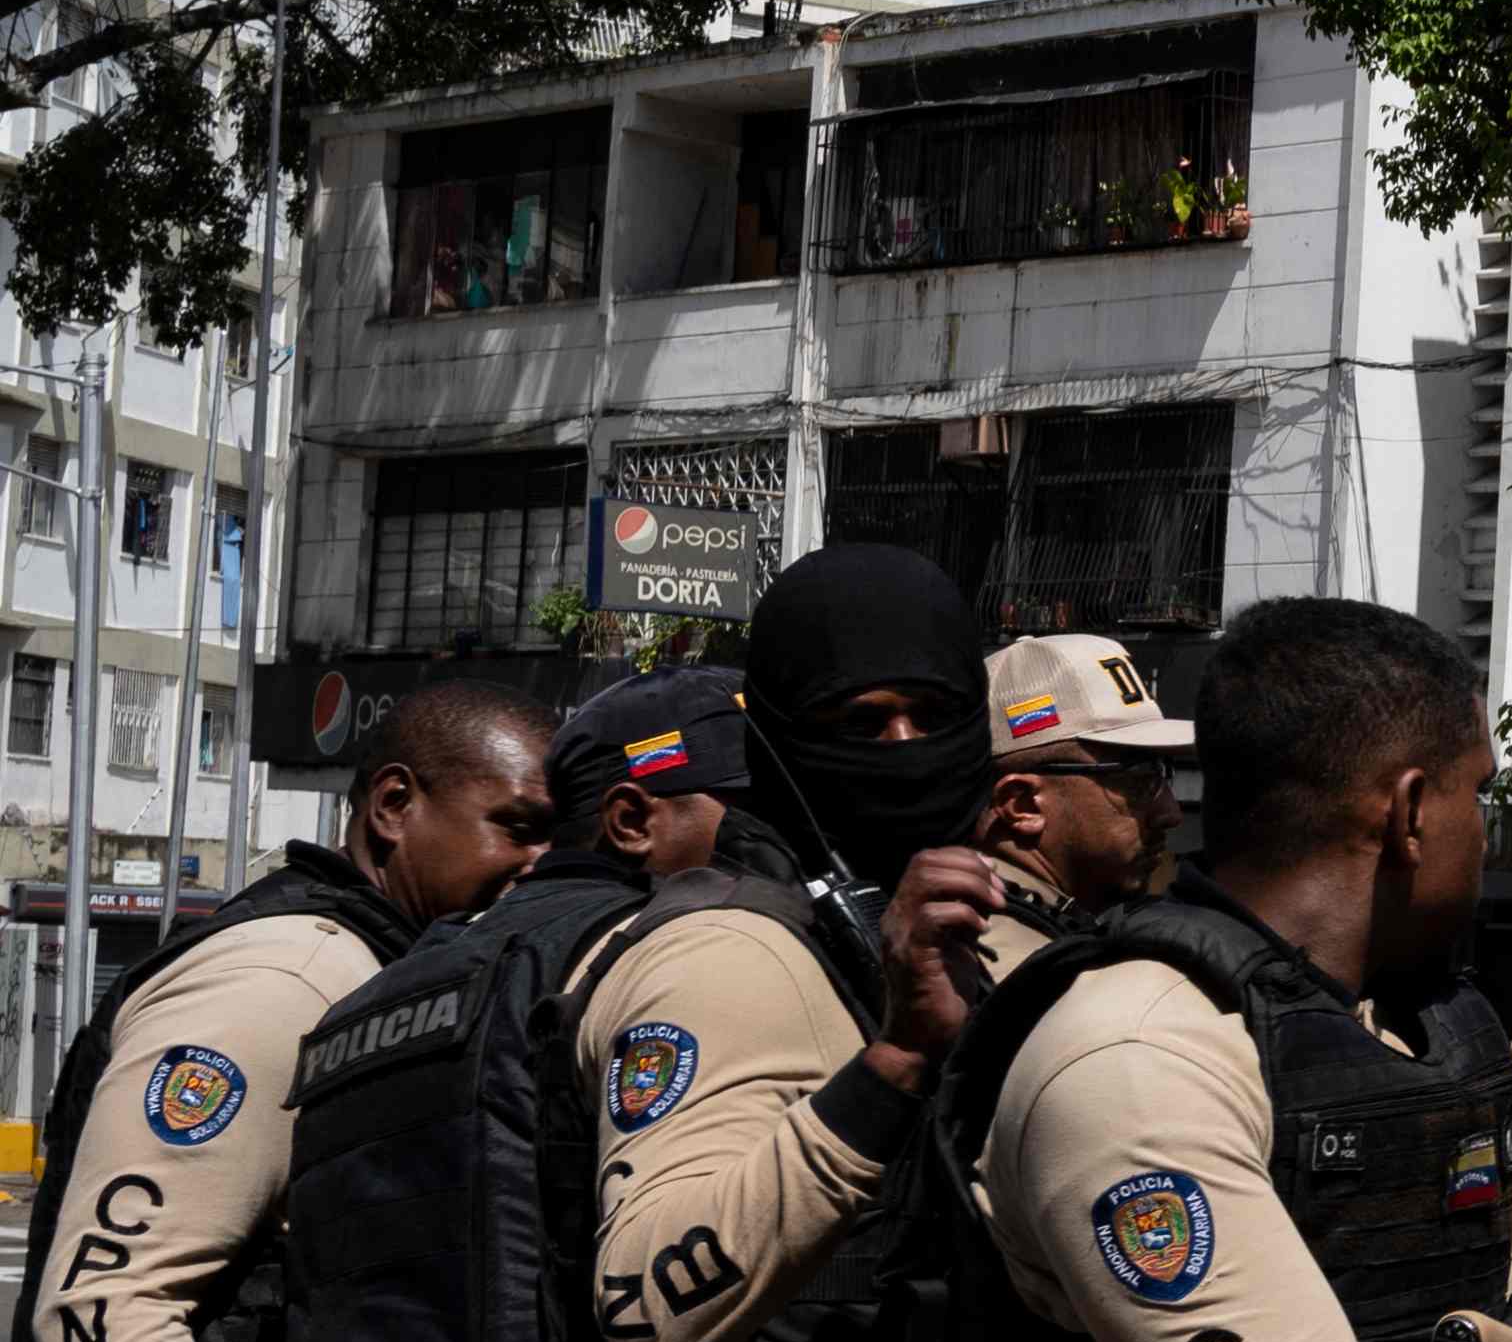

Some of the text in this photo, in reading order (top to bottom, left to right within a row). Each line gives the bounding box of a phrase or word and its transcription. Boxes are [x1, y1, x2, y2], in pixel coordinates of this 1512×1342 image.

[662, 524, 747, 554] pepsi
[620, 561, 739, 583] PANADERÍA PASTELERÍA
[637, 576, 723, 609] DORTA
[301, 989, 461, 1085] POLICIA
[629, 1025, 680, 1044] POLICIA
[185, 1047, 236, 1079] POLICIA
[1109, 1176, 1175, 1205] POLICIA
[1185, 1189, 1212, 1276] BOLIVARIANA
[1097, 1224, 1142, 1287] NACIONAL
